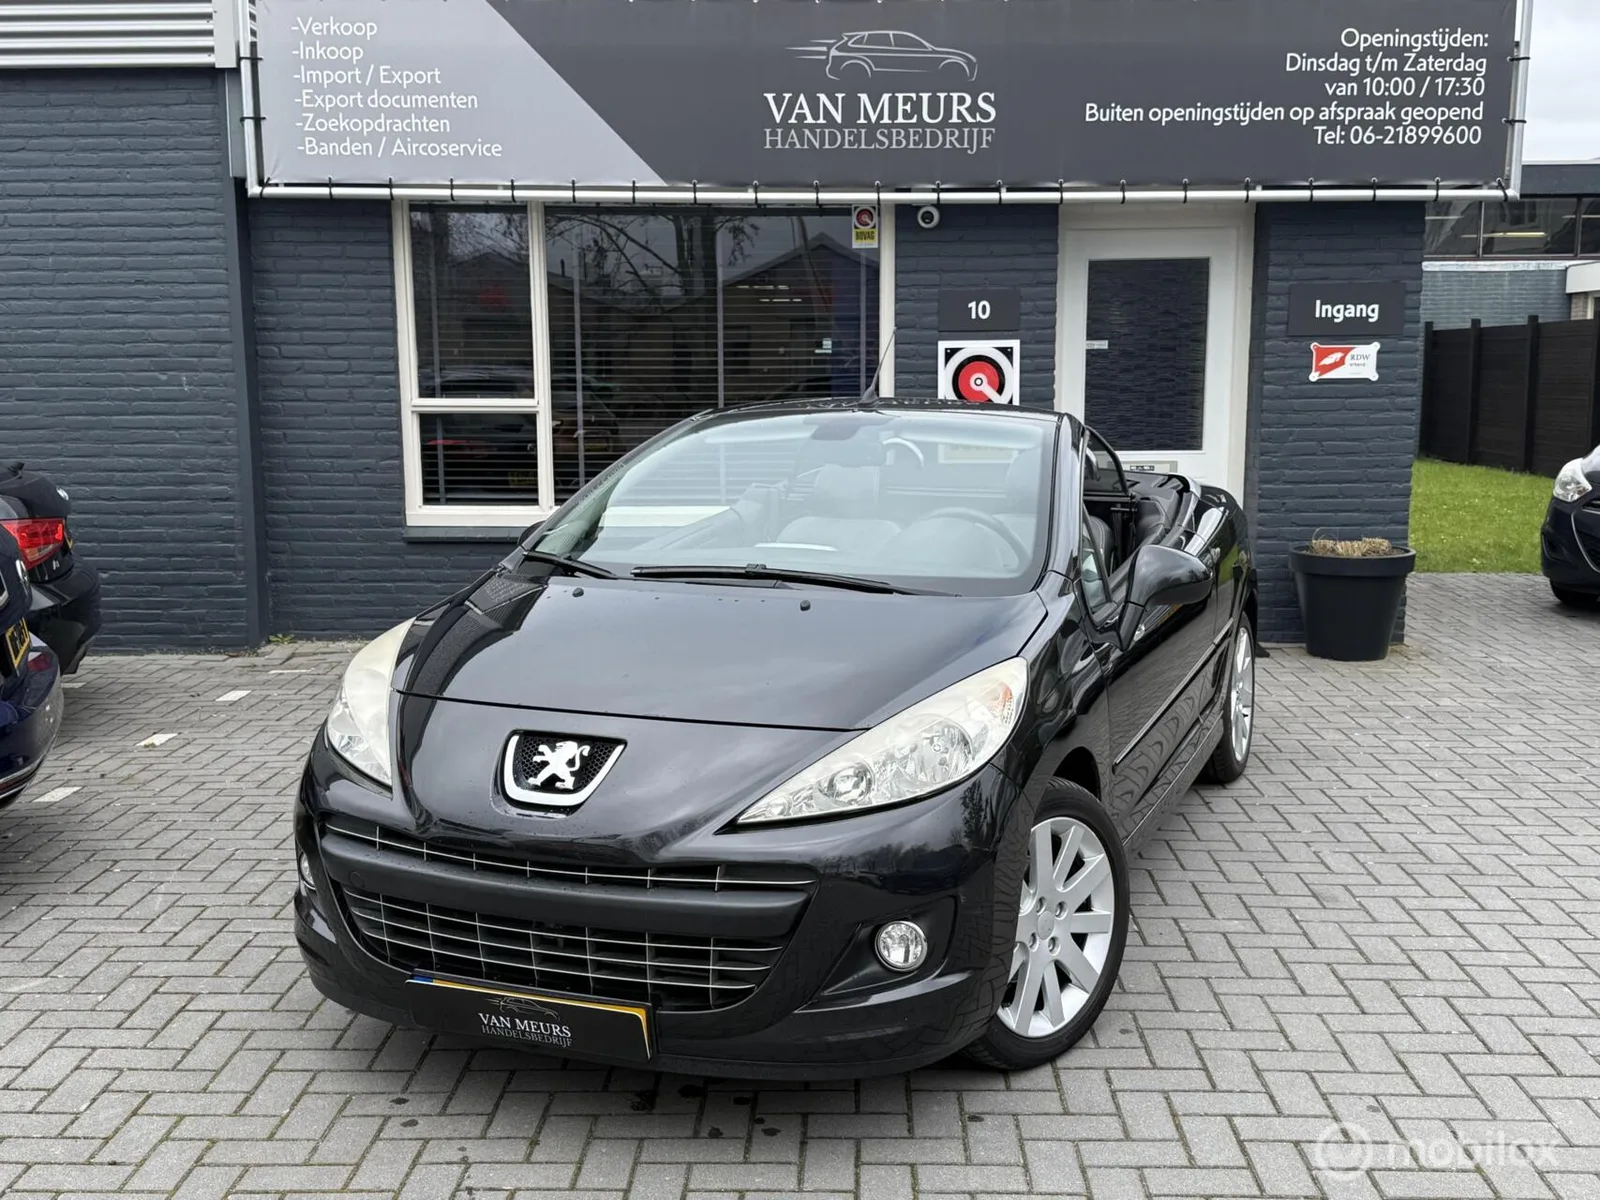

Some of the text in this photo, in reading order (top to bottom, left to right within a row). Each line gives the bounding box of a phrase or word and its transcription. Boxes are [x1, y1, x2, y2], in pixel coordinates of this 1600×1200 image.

[291, 15, 378, 41] -Verkoop
[1340, 27, 1489, 53] Openingstijden:
[291, 40, 364, 65] -Inkoop
[1285, 51, 1487, 77] Dinsdag t/m Zaterdag
[293, 64, 362, 89] -Import
[379, 65, 442, 89] Export
[1324, 82, 1358, 96] van
[1363, 76, 1416, 97] 10:00
[1434, 76, 1485, 96] 17:30
[294, 88, 478, 113] -Export documenten
[763, 91, 997, 124] VAN MEURS
[295, 112, 450, 137] -Zoekopdrachten
[1085, 100, 1484, 127] Buiten openingstijden op afspraak geopend
[297, 136, 373, 156] -Banden
[391, 138, 502, 157] Aircoservice
[763, 127, 996, 155] HANDELSBEDRIJF
[1313, 125, 1482, 145] Tel: 06-21899600
[855, 230, 876, 241] BOVAG
[967, 300, 991, 320] 10
[1315, 299, 1379, 323] Ingang
[1350, 353, 1371, 361] RDW
[478, 1012, 572, 1038] VAN MEURS
[481, 1025, 573, 1048] HANDELSBEDRIJF
